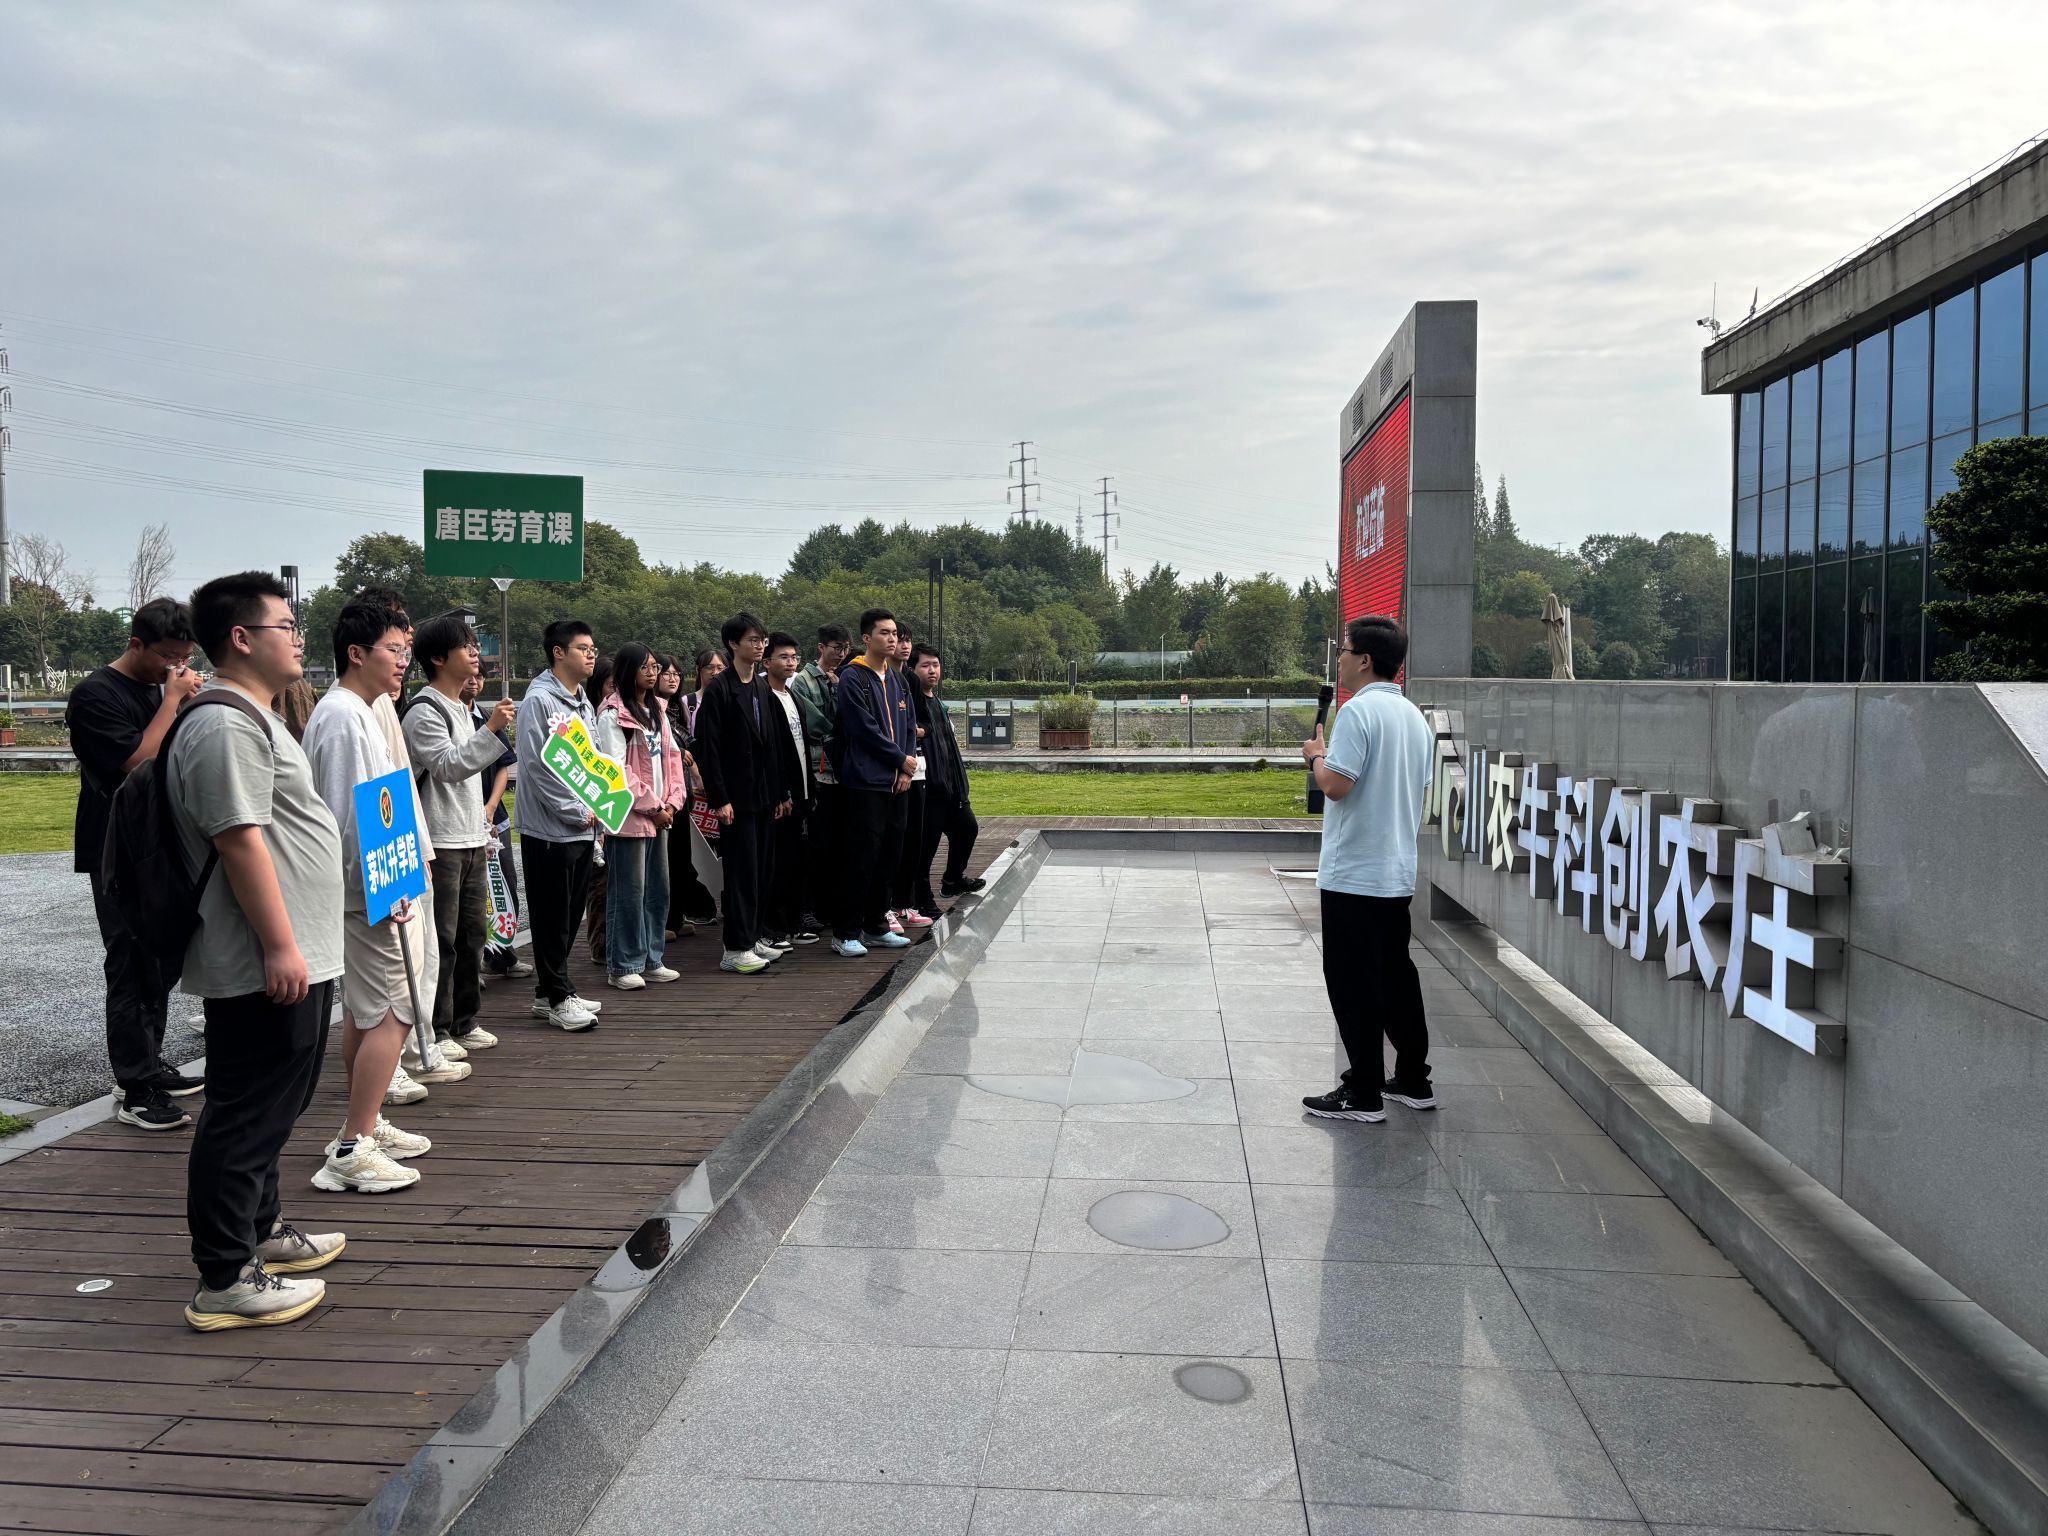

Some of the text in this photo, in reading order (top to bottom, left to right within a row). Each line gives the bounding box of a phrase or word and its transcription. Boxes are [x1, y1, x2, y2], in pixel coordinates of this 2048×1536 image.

[435, 507, 573, 546] 唐臣劳育课
[552, 747, 616, 820] 劳动育人
[571, 731, 619, 782] 耕读启智
[366, 830, 419, 895] 茅以升学院
[1461, 745, 1822, 1056] 川农牛科创农庄
